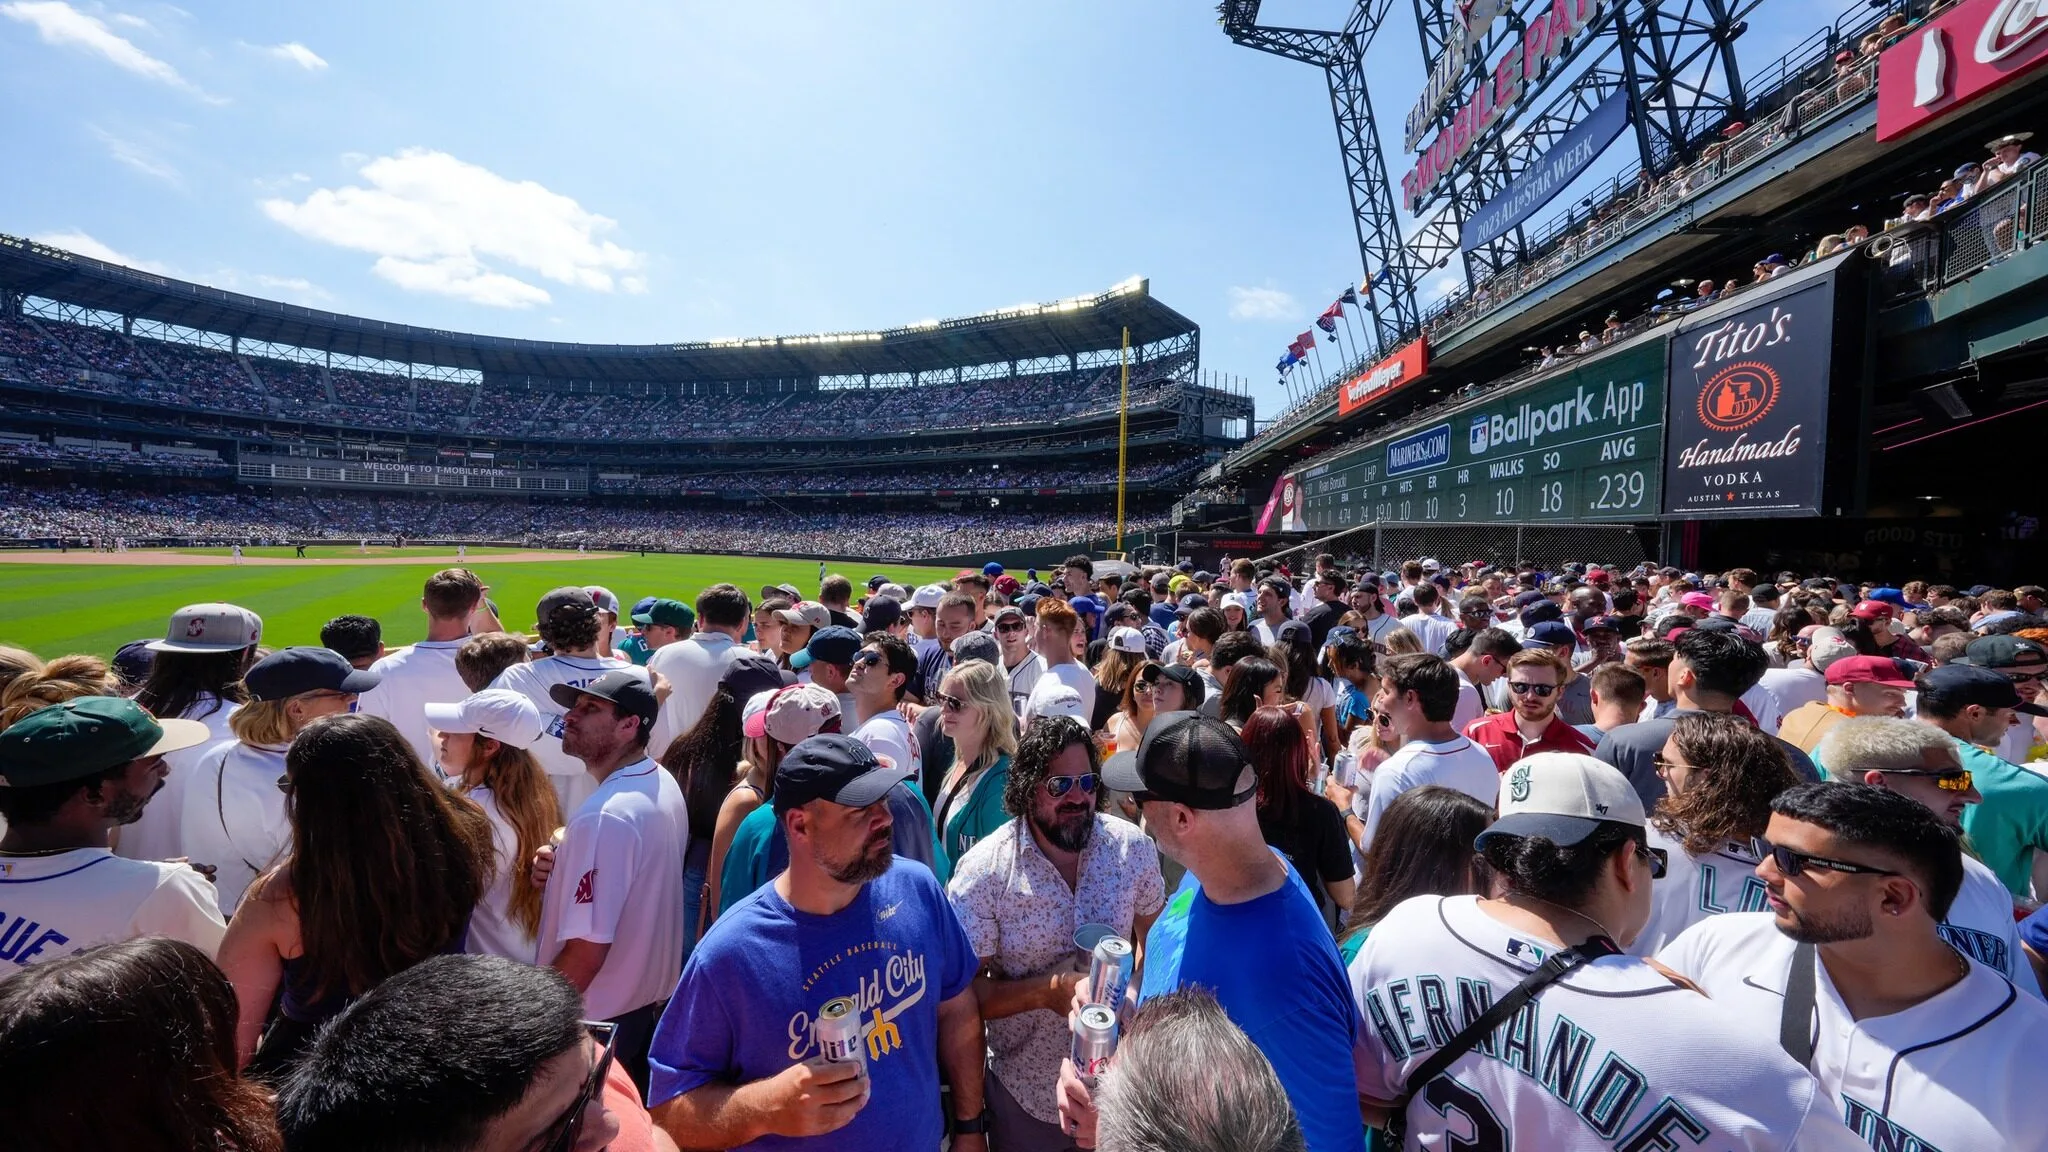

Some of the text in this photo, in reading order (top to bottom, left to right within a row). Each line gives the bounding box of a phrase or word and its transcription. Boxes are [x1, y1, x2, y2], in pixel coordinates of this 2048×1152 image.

[1536, 155, 1546, 174] OF
[1476, 211, 1501, 244] 2023
[1553, 134, 1594, 183] WEEK
[1693, 307, 1792, 369] Tito's
[1490, 380, 1644, 447] Ballpark App
[363, 461, 505, 477] WELCOME TO T-MOBILE PARK
[1400, 480, 1413, 494] HITS
[1428, 475, 1437, 489] ER
[1457, 469, 1470, 485] HR
[1489, 458, 1524, 479] WALKS
[1543, 451, 1561, 471] SO
[1600, 436, 1637, 462] AVG
[1678, 424, 1801, 470] Handmade
[1360, 505, 1368, 523] 24
[1400, 500, 1411, 521] 10
[1426, 496, 1439, 520] 10
[1458, 493, 1467, 518] 3
[1495, 487, 1514, 516] 10
[1540, 481, 1562, 513] 18
[1590, 470, 1645, 510] .239
[1364, 464, 1377, 483] LHP
[1687, 490, 1781, 503] AUSTIN TEXAS
[1703, 471, 1764, 487] VODKA
[1864, 526, 1916, 545] GOOD
[803, 941, 897, 992] SEATTLE BASEBALL
[886, 949, 926, 998] City
[823, 1033, 858, 1064] Lite
